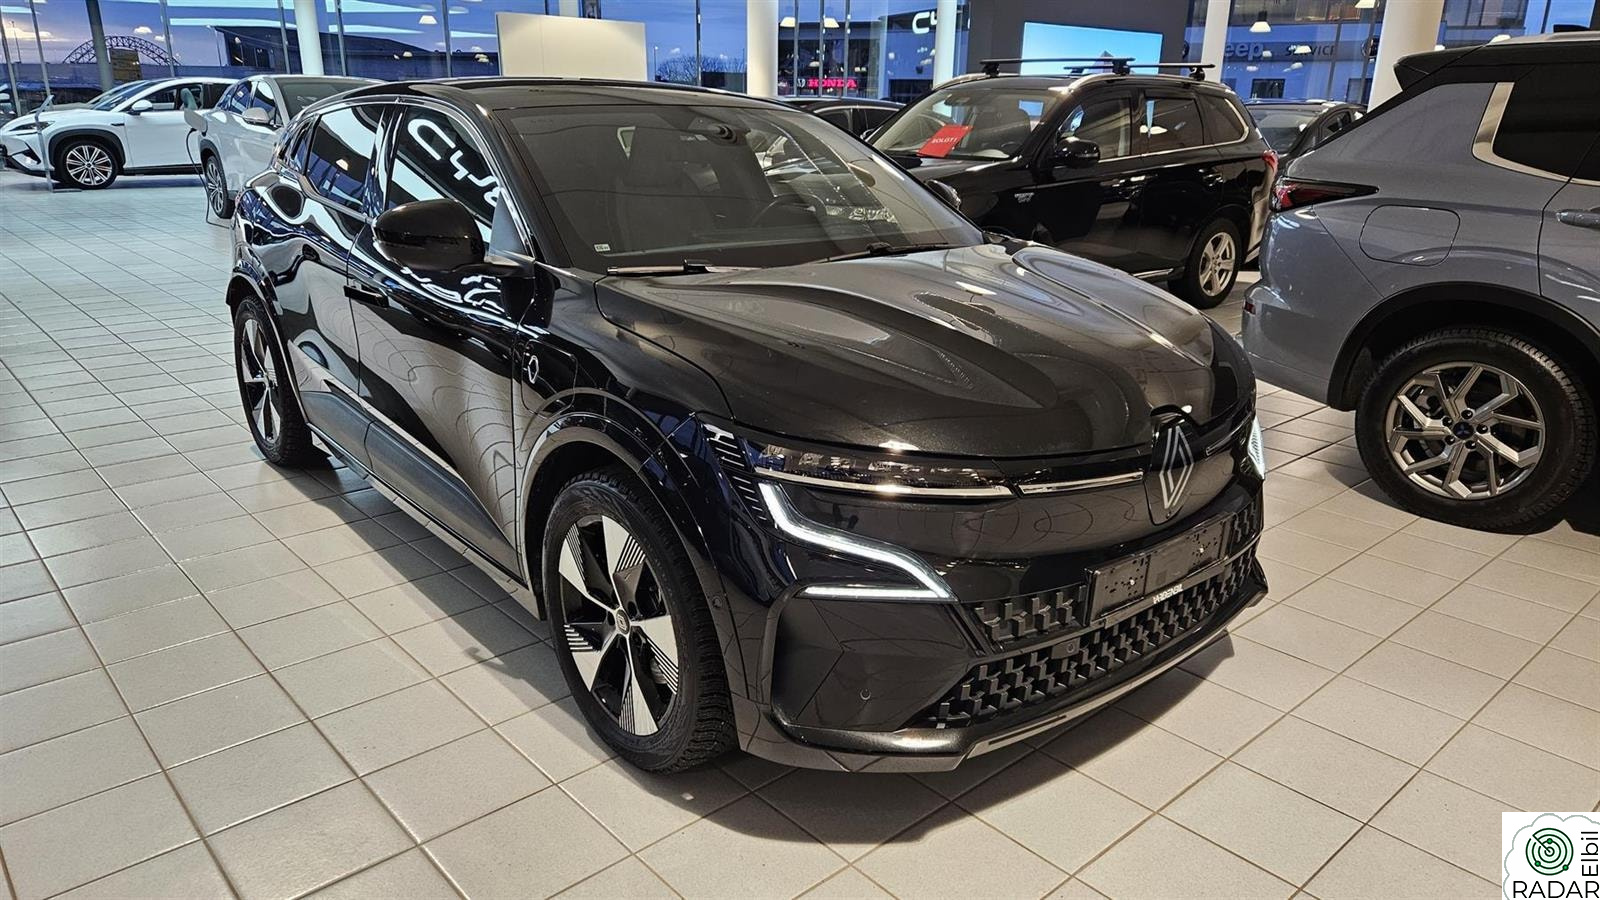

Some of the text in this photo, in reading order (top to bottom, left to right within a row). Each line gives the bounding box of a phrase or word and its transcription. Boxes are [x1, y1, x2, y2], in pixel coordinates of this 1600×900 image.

[1224, 43, 1263, 60] eep
[1285, 44, 1336, 56] SVIC
[808, 79, 856, 87] HONDA
